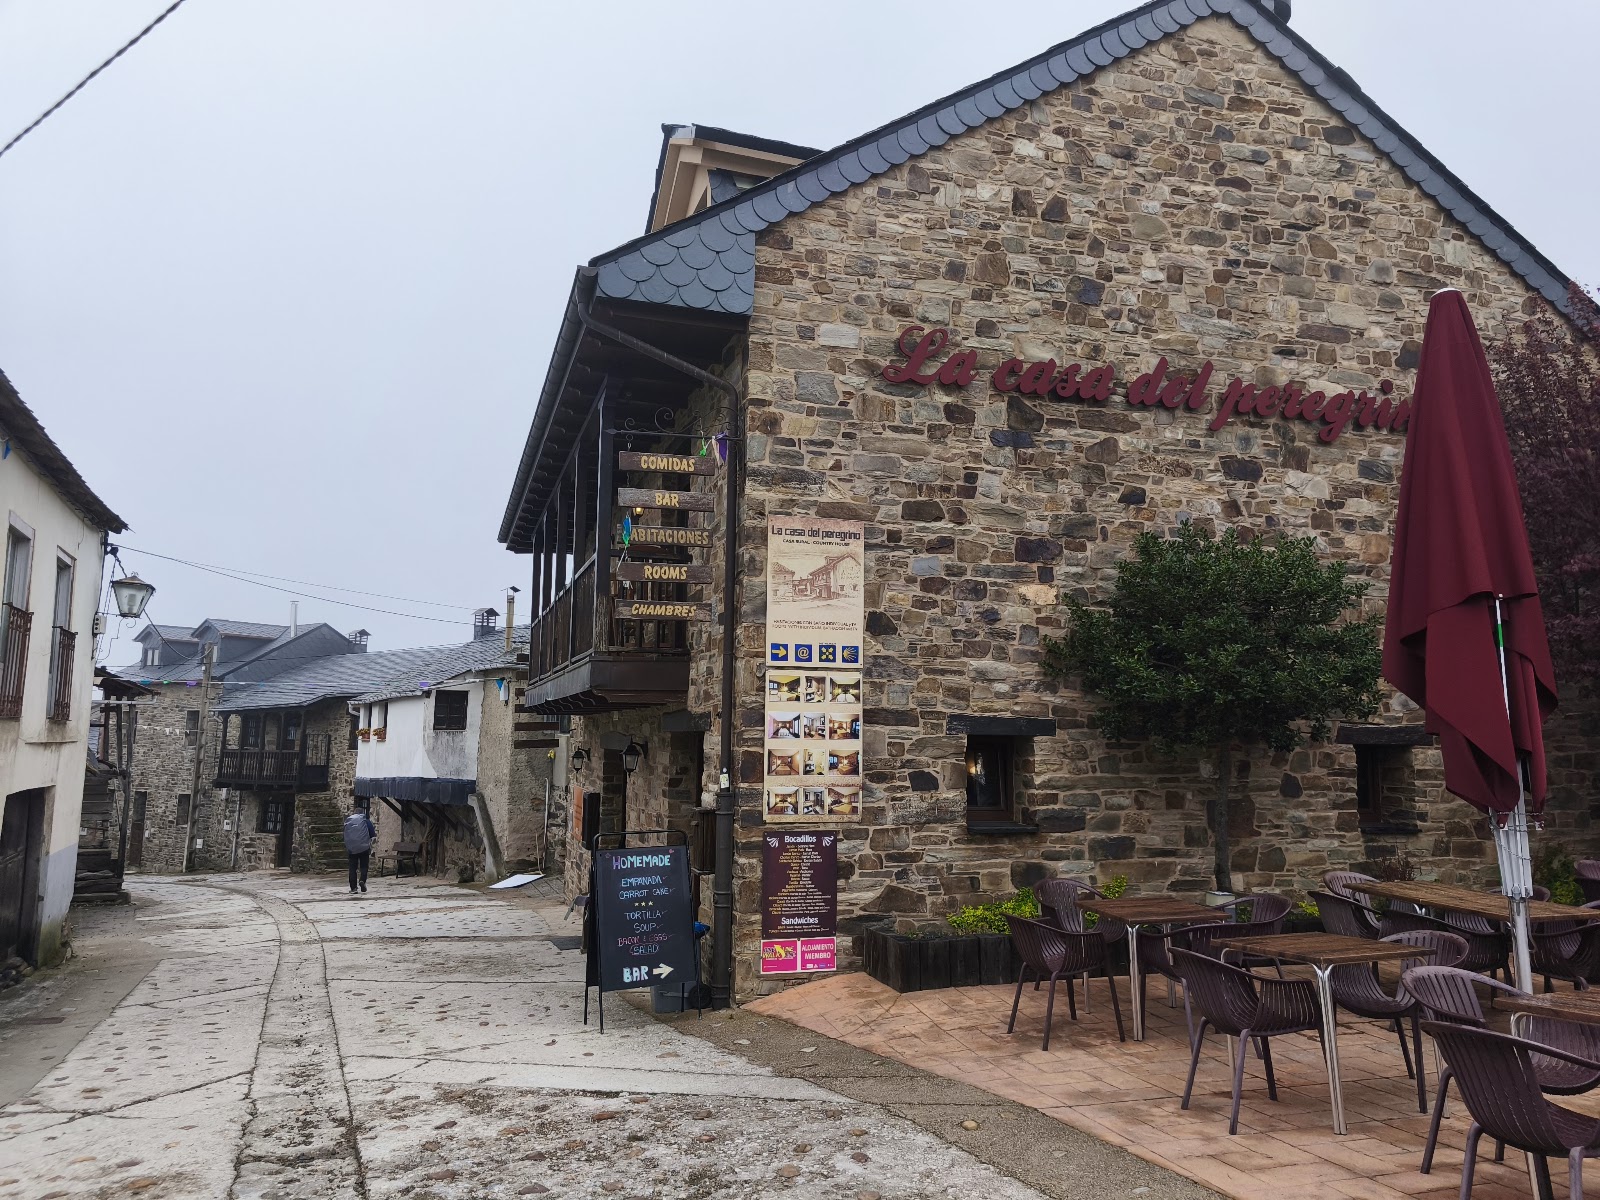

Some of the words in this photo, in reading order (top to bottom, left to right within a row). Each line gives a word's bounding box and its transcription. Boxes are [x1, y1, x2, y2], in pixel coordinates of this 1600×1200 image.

[883, 326, 979, 386] La
[991, 358, 1116, 401] casa
[1127, 356, 1214, 408] del
[1210, 376, 1411, 442] peregrin
[640, 456, 695, 471] COMIDAS
[655, 493, 680, 508] BAR
[630, 529, 709, 545] ABITACIONES
[771, 524, 783, 536] La
[785, 528, 806, 537] casa
[807, 527, 820, 538] del
[822, 530, 861, 542] peregrino
[643, 565, 688, 580] ROOMS
[631, 603, 697, 617] CHAMBRES
[784, 835, 817, 843] Bocadillos
[612, 854, 671, 870] HOMEMADE
[621, 875, 662, 887] EMPANADA
[619, 889, 649, 900] CARROT
[652, 887, 669, 896] CAKE
[624, 909, 662, 921] TORTILLA
[781, 916, 819, 925] Sandwiches
[633, 922, 657, 933] SOUP
[801, 944, 834, 952] ALOJAMIENTO
[804, 952, 831, 960] MIEMBRO
[622, 965, 649, 983] BAR
